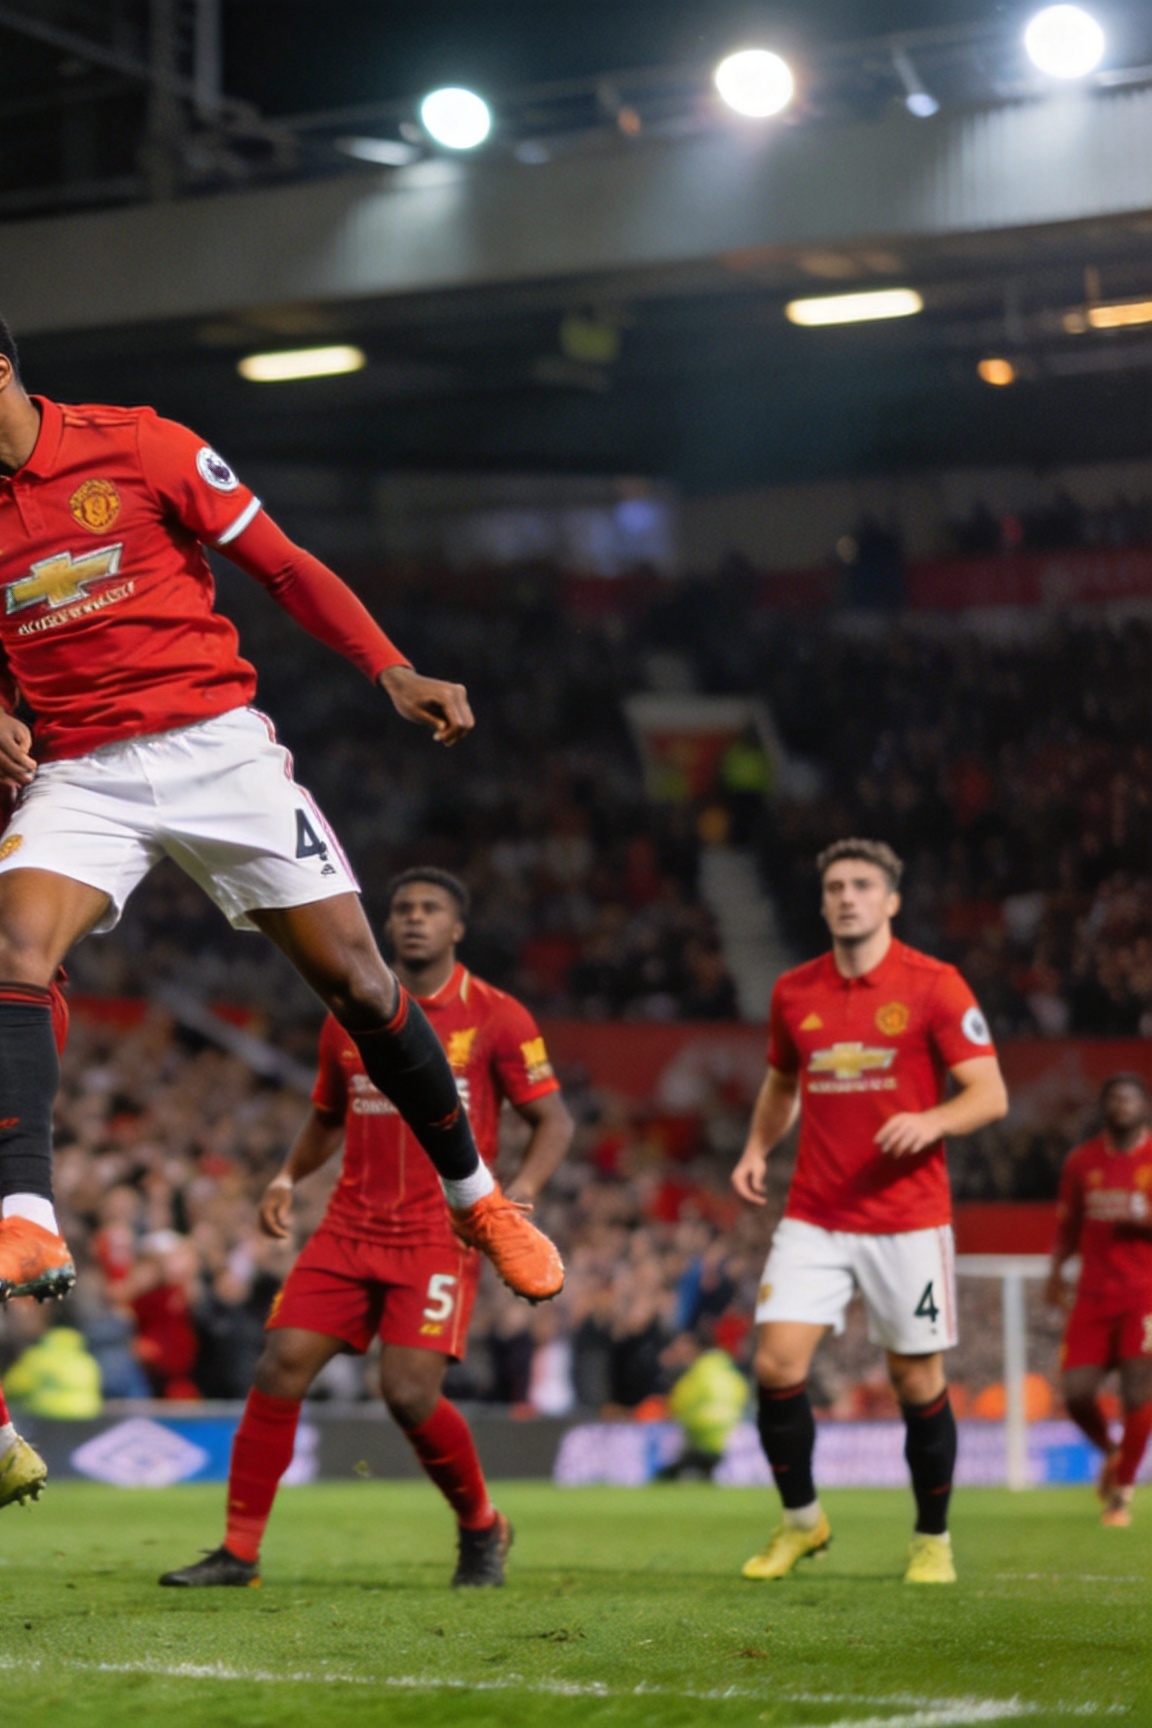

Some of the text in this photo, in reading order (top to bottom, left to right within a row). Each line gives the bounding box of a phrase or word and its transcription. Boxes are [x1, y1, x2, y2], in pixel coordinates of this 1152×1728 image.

[295, 808, 328, 862] 4
[424, 1273, 456, 1321] 5
[914, 1280, 940, 1323] 4
